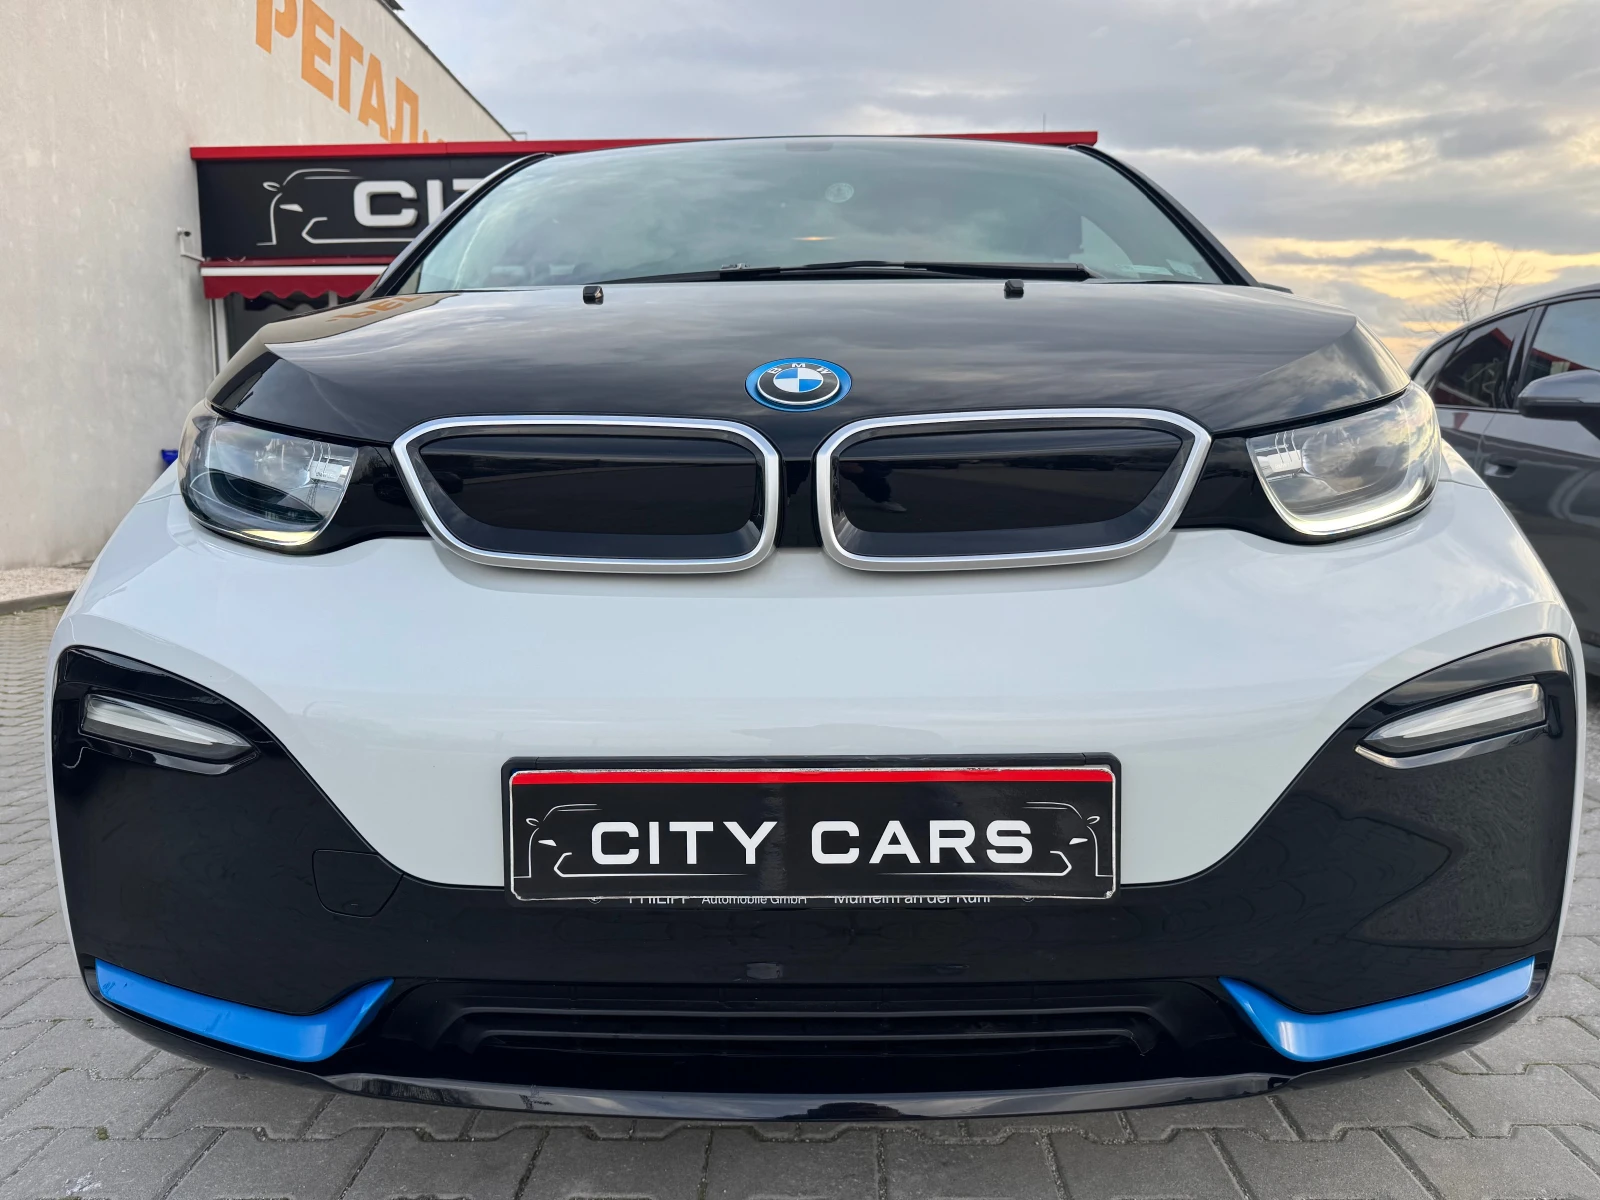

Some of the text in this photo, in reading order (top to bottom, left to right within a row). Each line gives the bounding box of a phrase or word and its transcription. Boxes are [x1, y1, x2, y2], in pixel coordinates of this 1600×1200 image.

[767, 362, 832, 375] BMW
[591, 820, 1033, 865] CITY CARS
